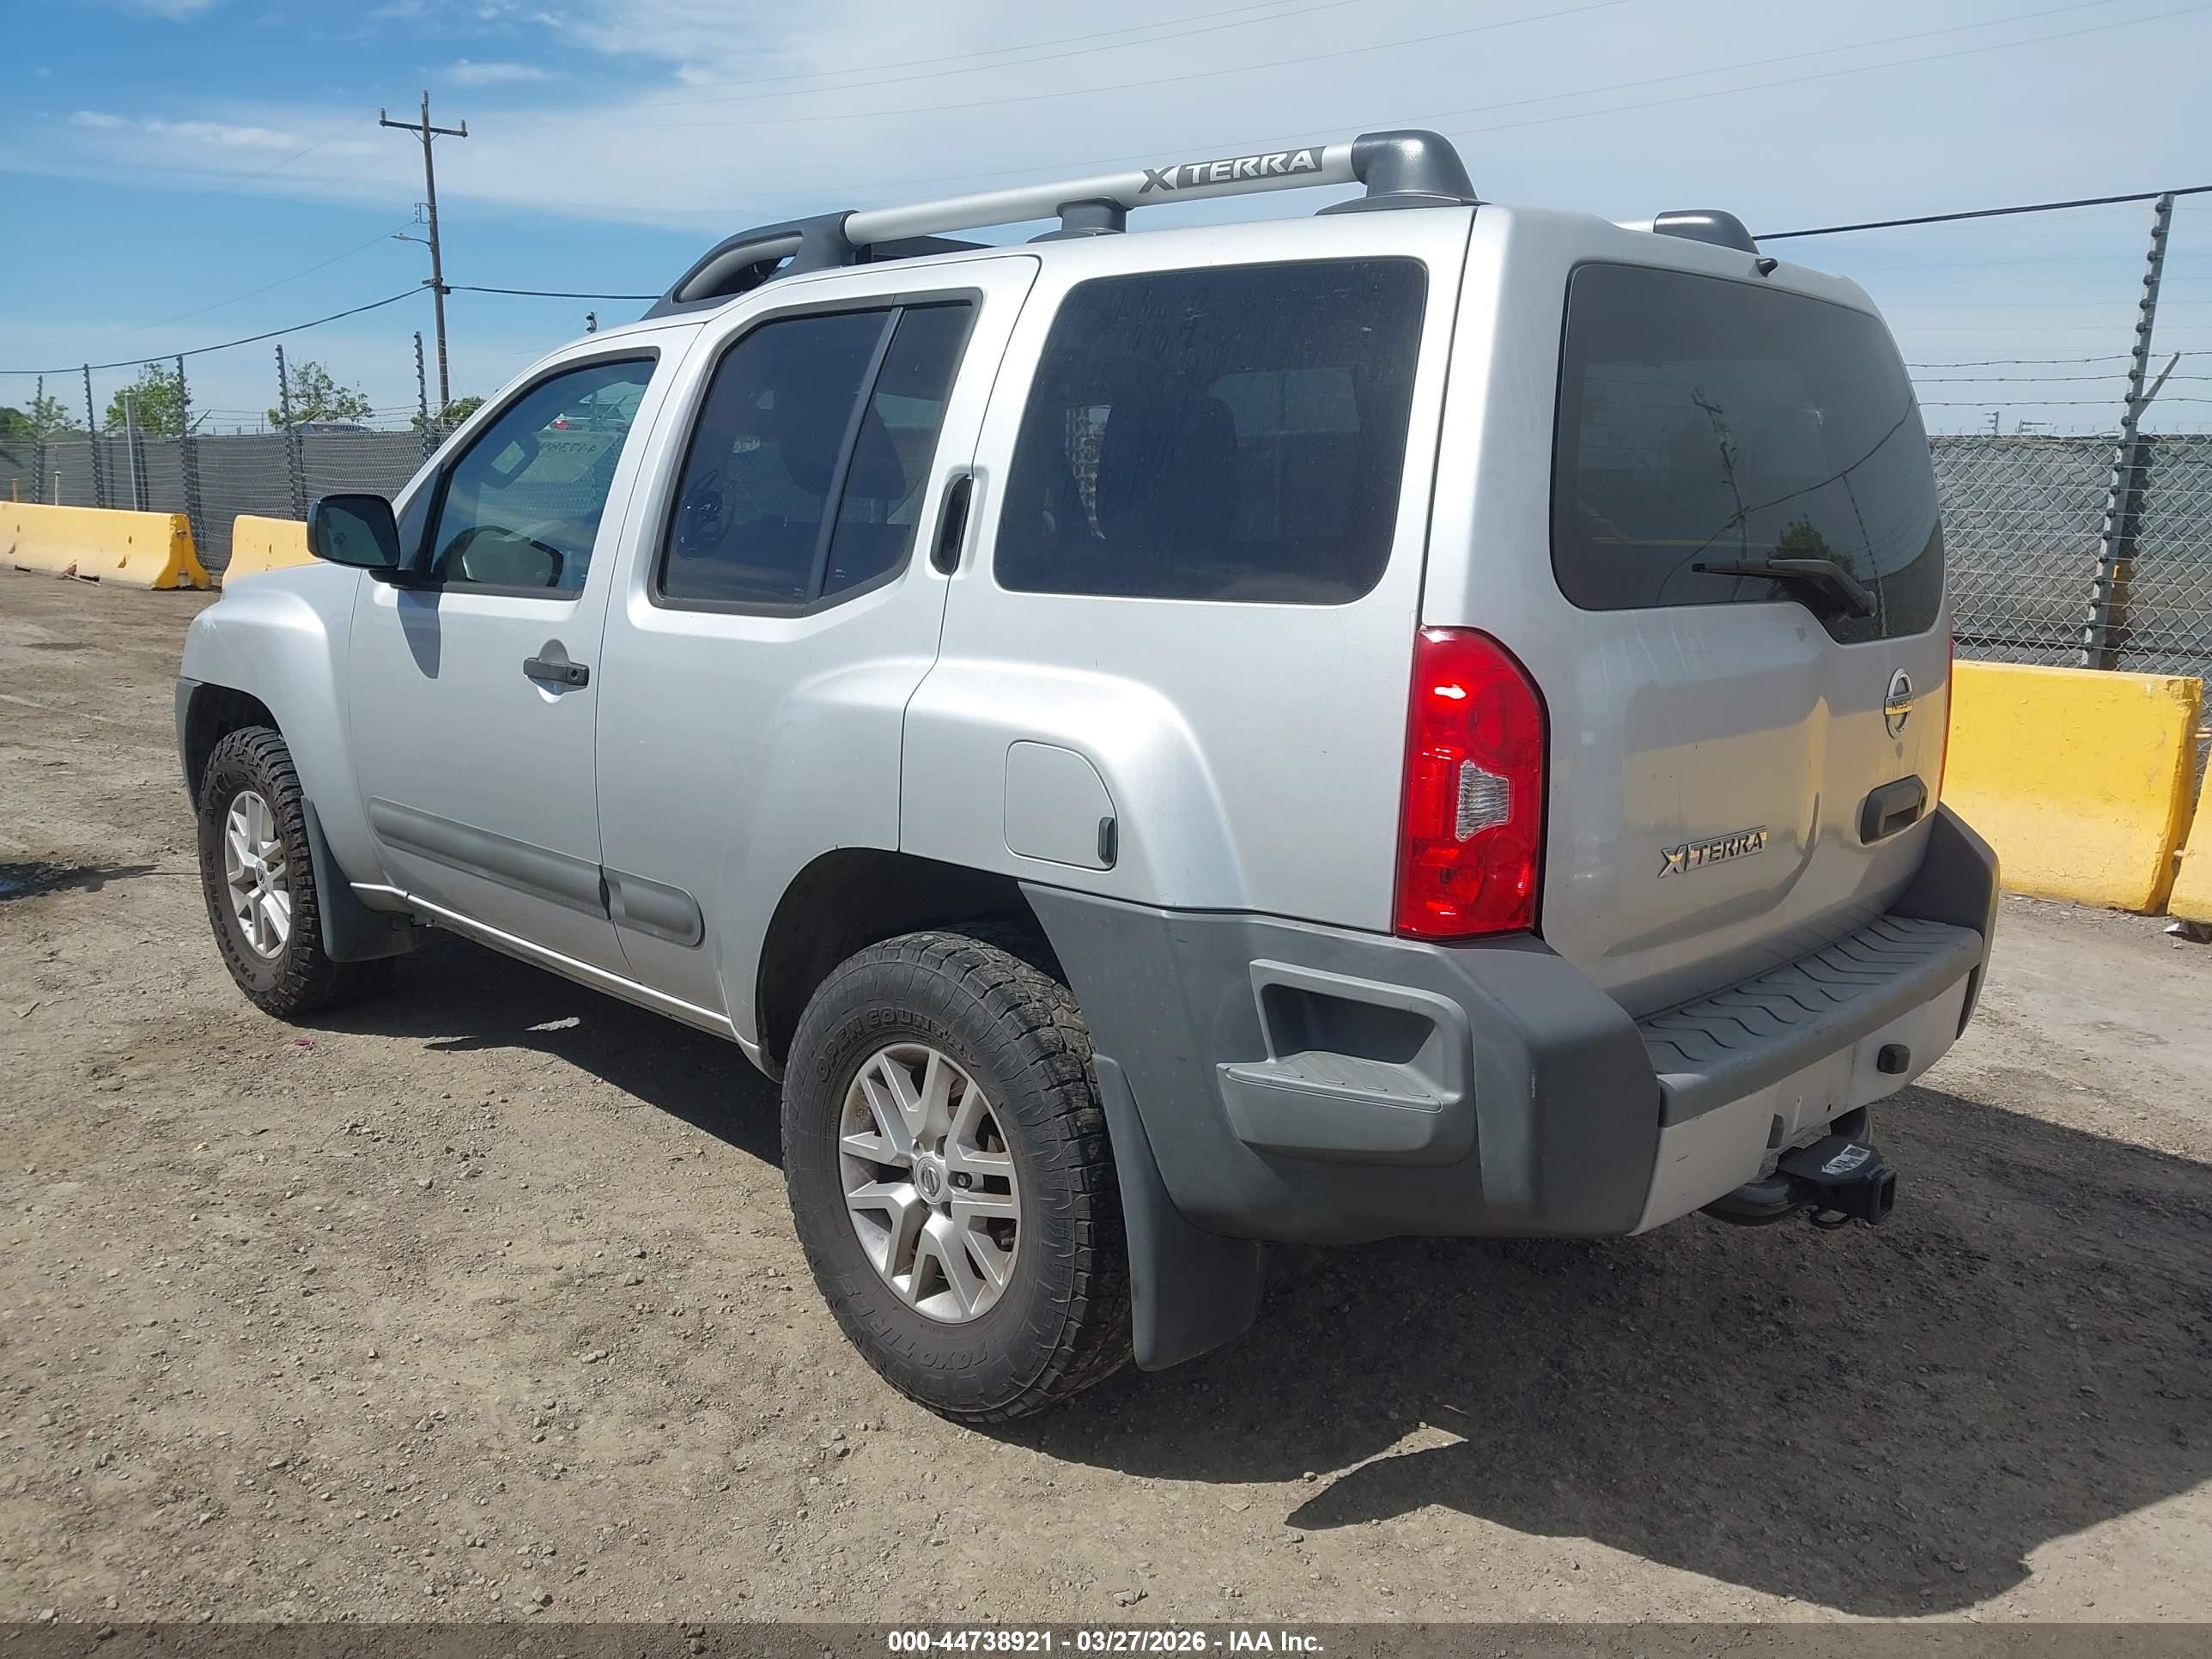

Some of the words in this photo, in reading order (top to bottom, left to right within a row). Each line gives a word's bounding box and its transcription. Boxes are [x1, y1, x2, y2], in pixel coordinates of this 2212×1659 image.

[1139, 149, 1317, 193] XTERRA
[1658, 828, 1765, 878] XTERRA
[817, 1017, 864, 1081] OPEN
